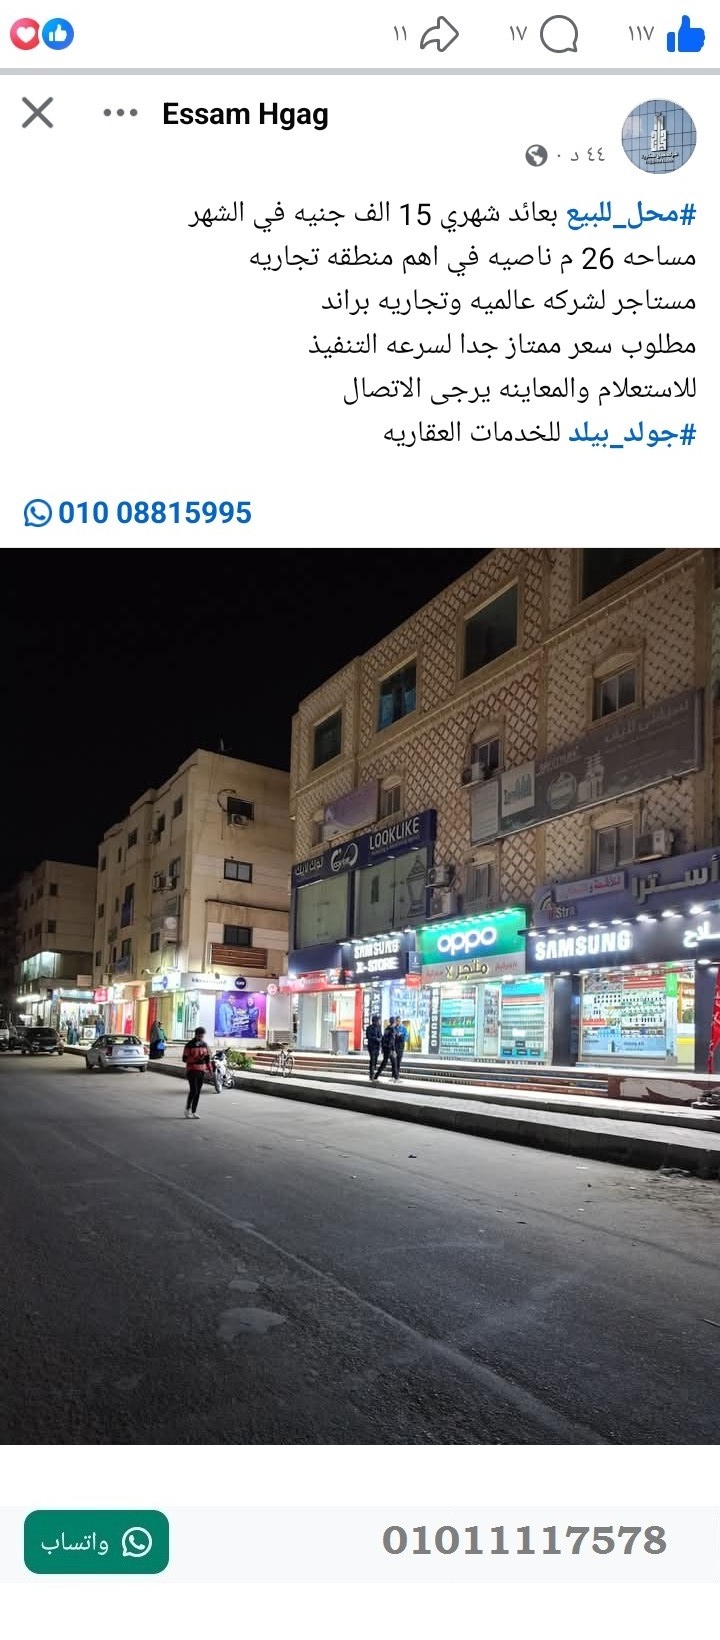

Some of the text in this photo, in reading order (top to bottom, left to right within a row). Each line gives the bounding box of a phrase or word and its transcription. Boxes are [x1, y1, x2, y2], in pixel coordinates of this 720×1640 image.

[369, 817, 420, 850] LOOKLIKE
[353, 938, 400, 960] SAMSUNG
[437, 926, 498, 956] oppo
[534, 930, 632, 961] SAMSUNG
[456, 958, 489, 980] متجر
